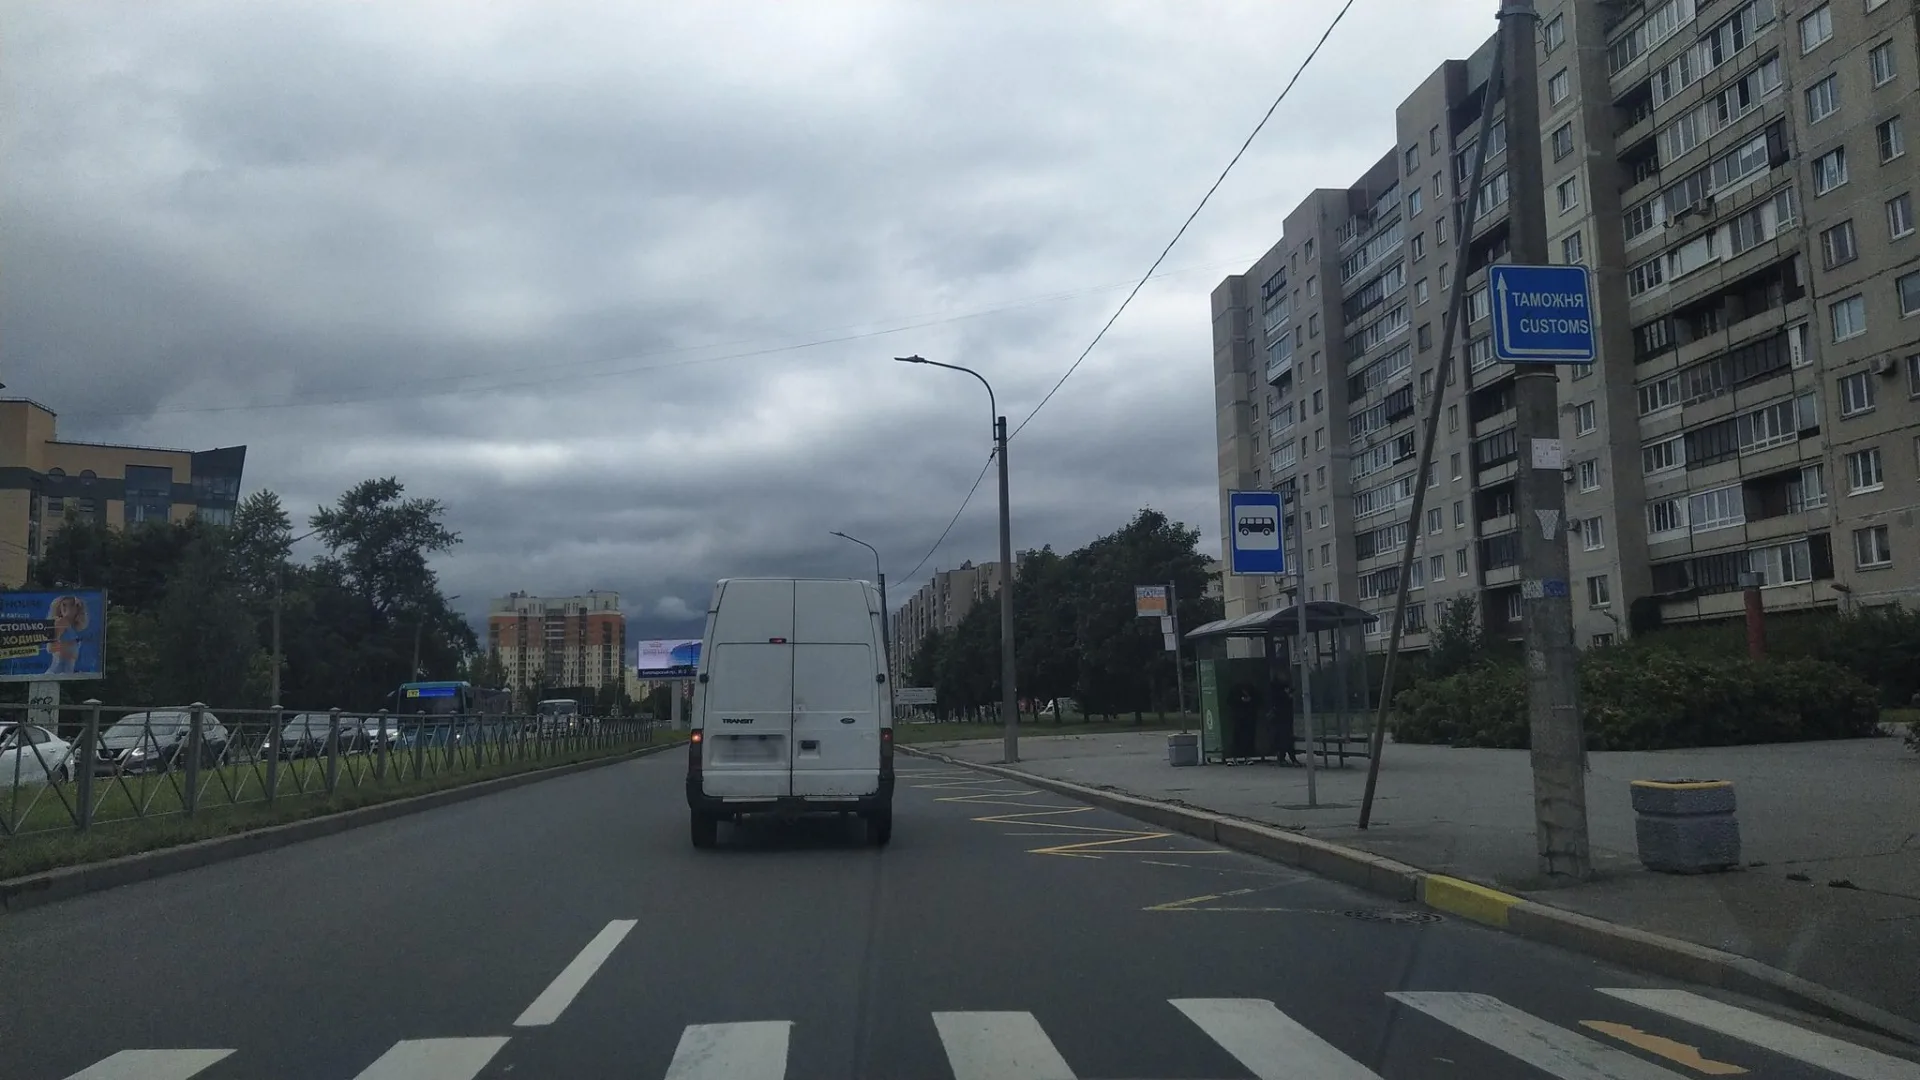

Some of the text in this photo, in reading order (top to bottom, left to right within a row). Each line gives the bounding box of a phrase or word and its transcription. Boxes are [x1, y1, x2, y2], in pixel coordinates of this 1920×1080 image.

[1512, 292, 1585, 308] ТАМОЖНЯ
[1520, 318, 1589, 334] CUSTOMS
[0, 622, 47, 632] СТОЛЬКО,
[3, 634, 48, 646] ХОДИШЬ
